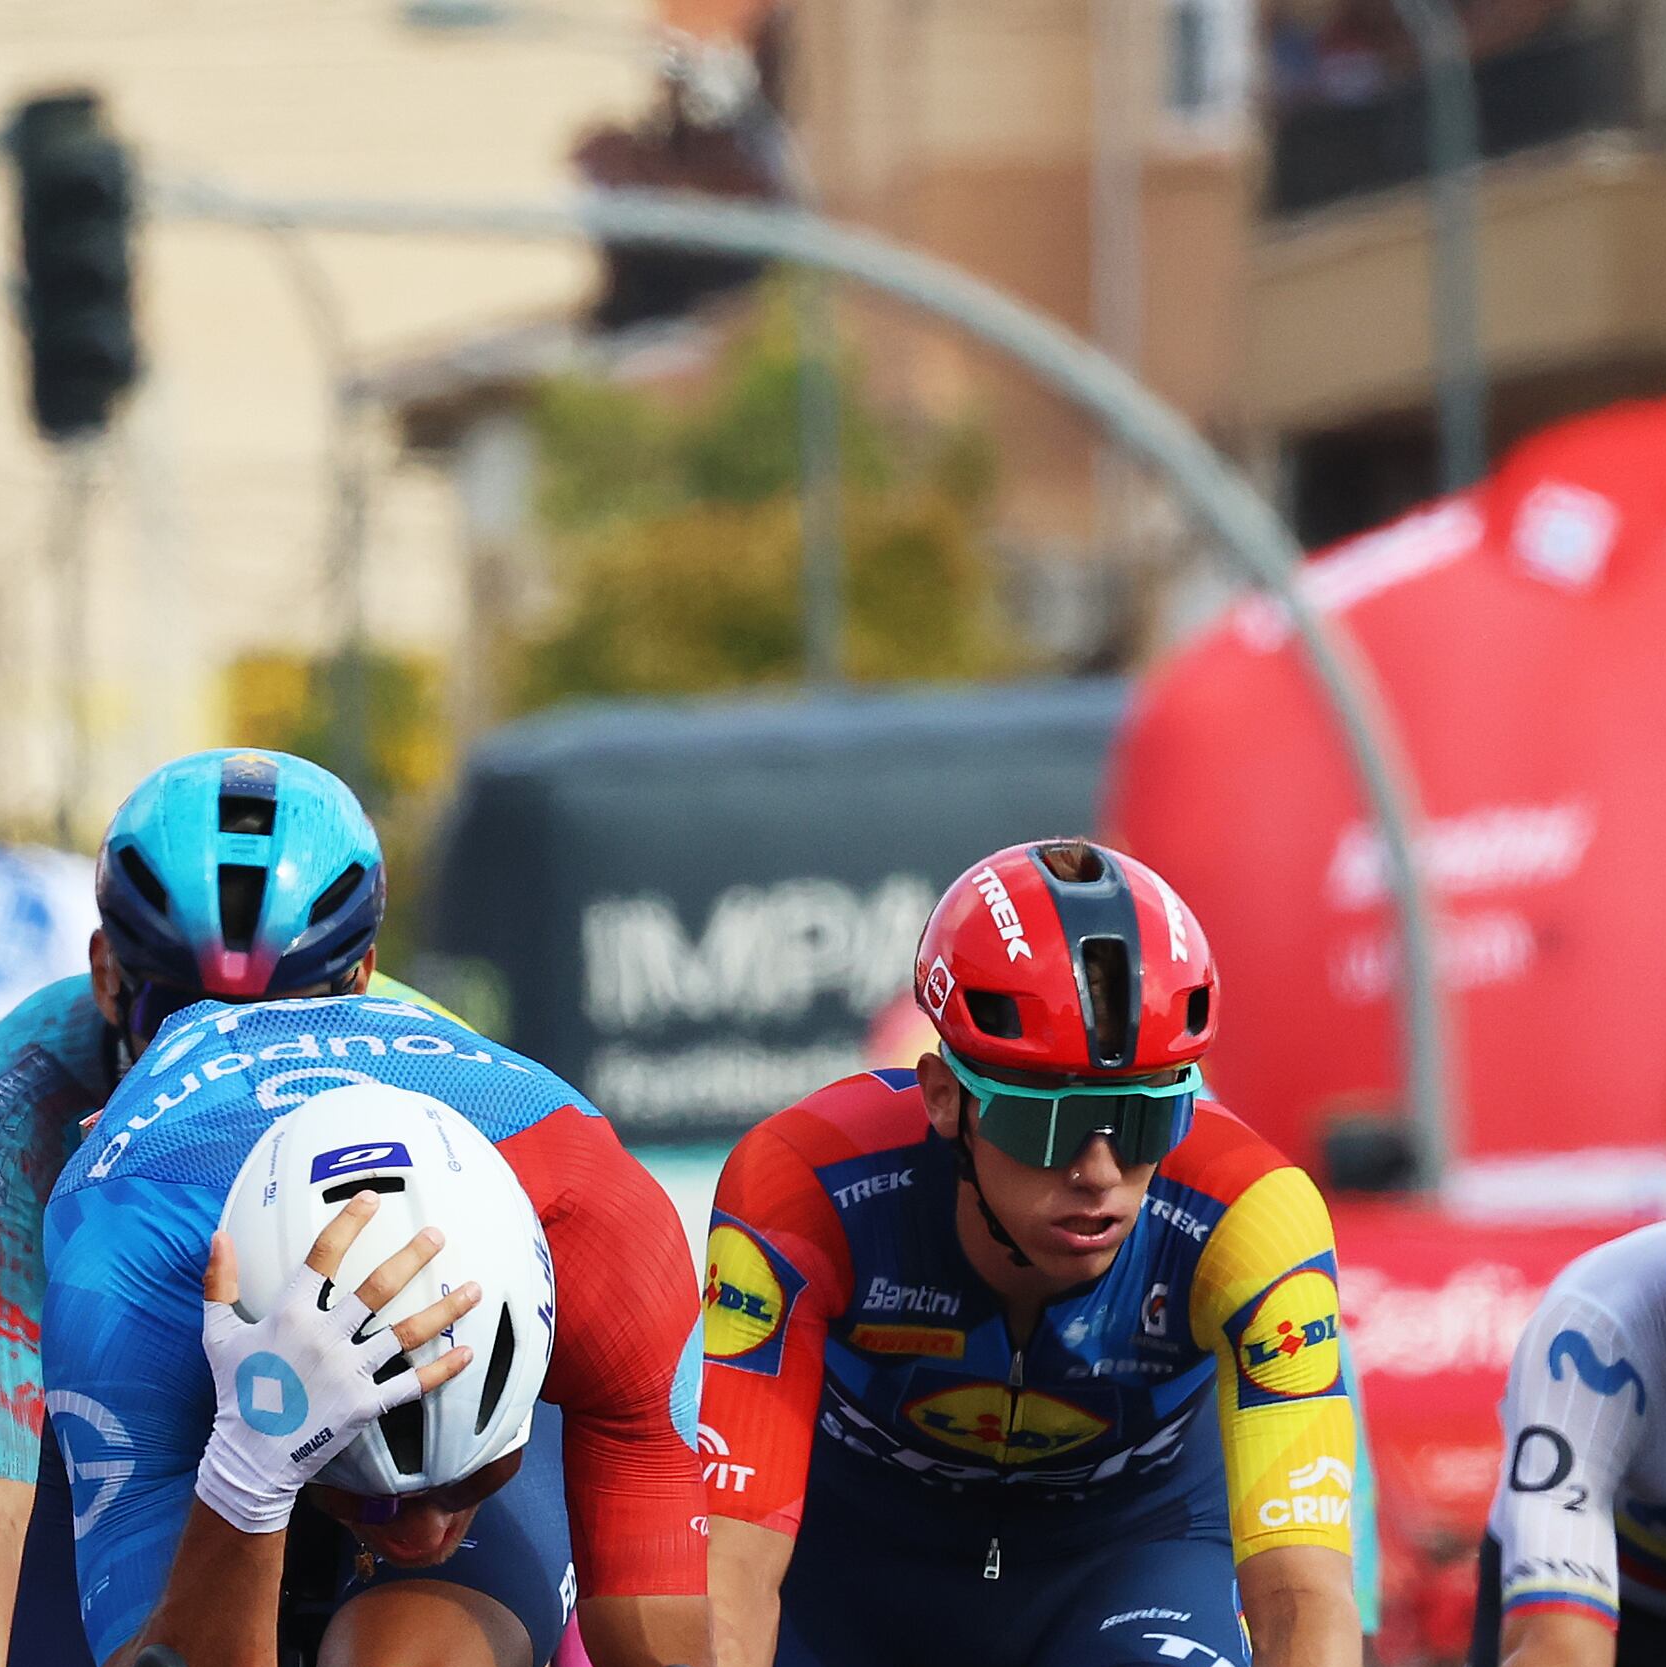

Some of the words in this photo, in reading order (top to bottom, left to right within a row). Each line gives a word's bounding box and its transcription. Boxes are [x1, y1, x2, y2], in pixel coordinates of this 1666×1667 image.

[972, 865, 1033, 962] TREK
[85, 1033, 534, 1179] roupama
[833, 1167, 915, 1209] TREK
[1143, 1192, 1210, 1243] TREK
[863, 1276, 963, 1316] Santini
[289, 1427, 335, 1465] BIORACER
